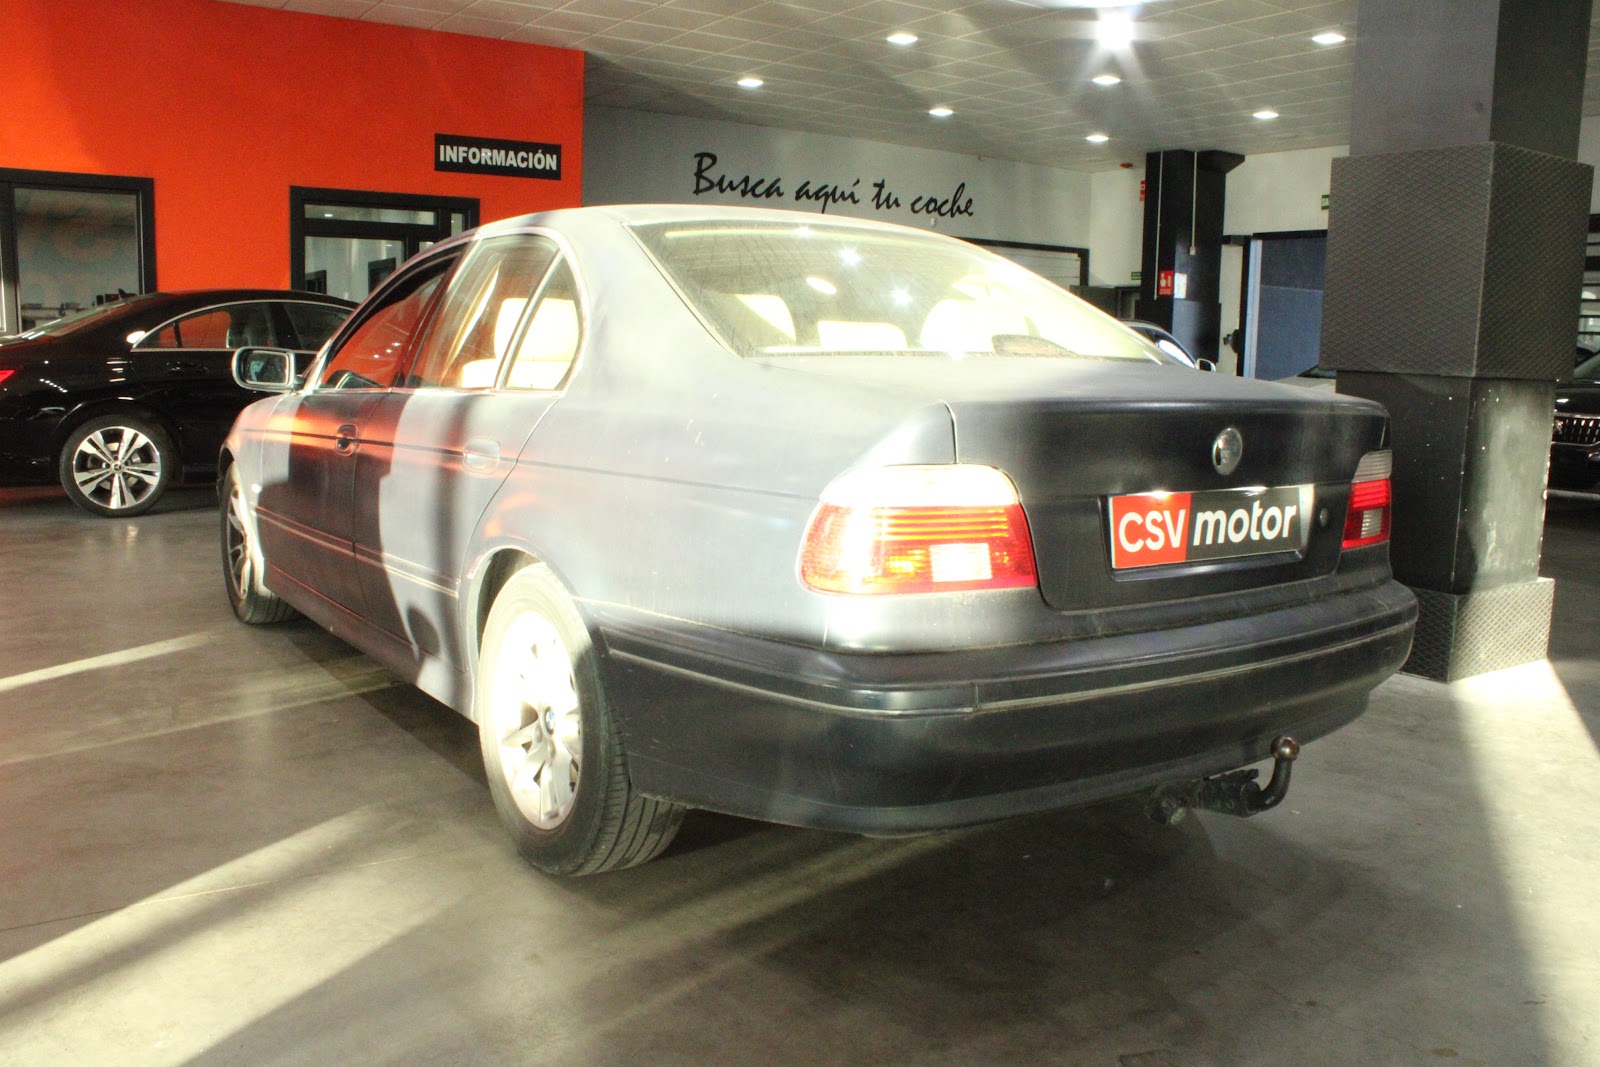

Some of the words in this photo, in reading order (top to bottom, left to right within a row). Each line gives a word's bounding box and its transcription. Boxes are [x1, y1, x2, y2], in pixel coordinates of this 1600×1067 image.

[439, 144, 557, 170] INFORMACIÓN
[693, 152, 784, 198] Busca
[794, 178, 860, 214] aquí
[871, 179, 901, 210] tu
[910, 182, 973, 217] coche
[1118, 509, 1186, 553] CSV
[1193, 500, 1297, 546] motor
